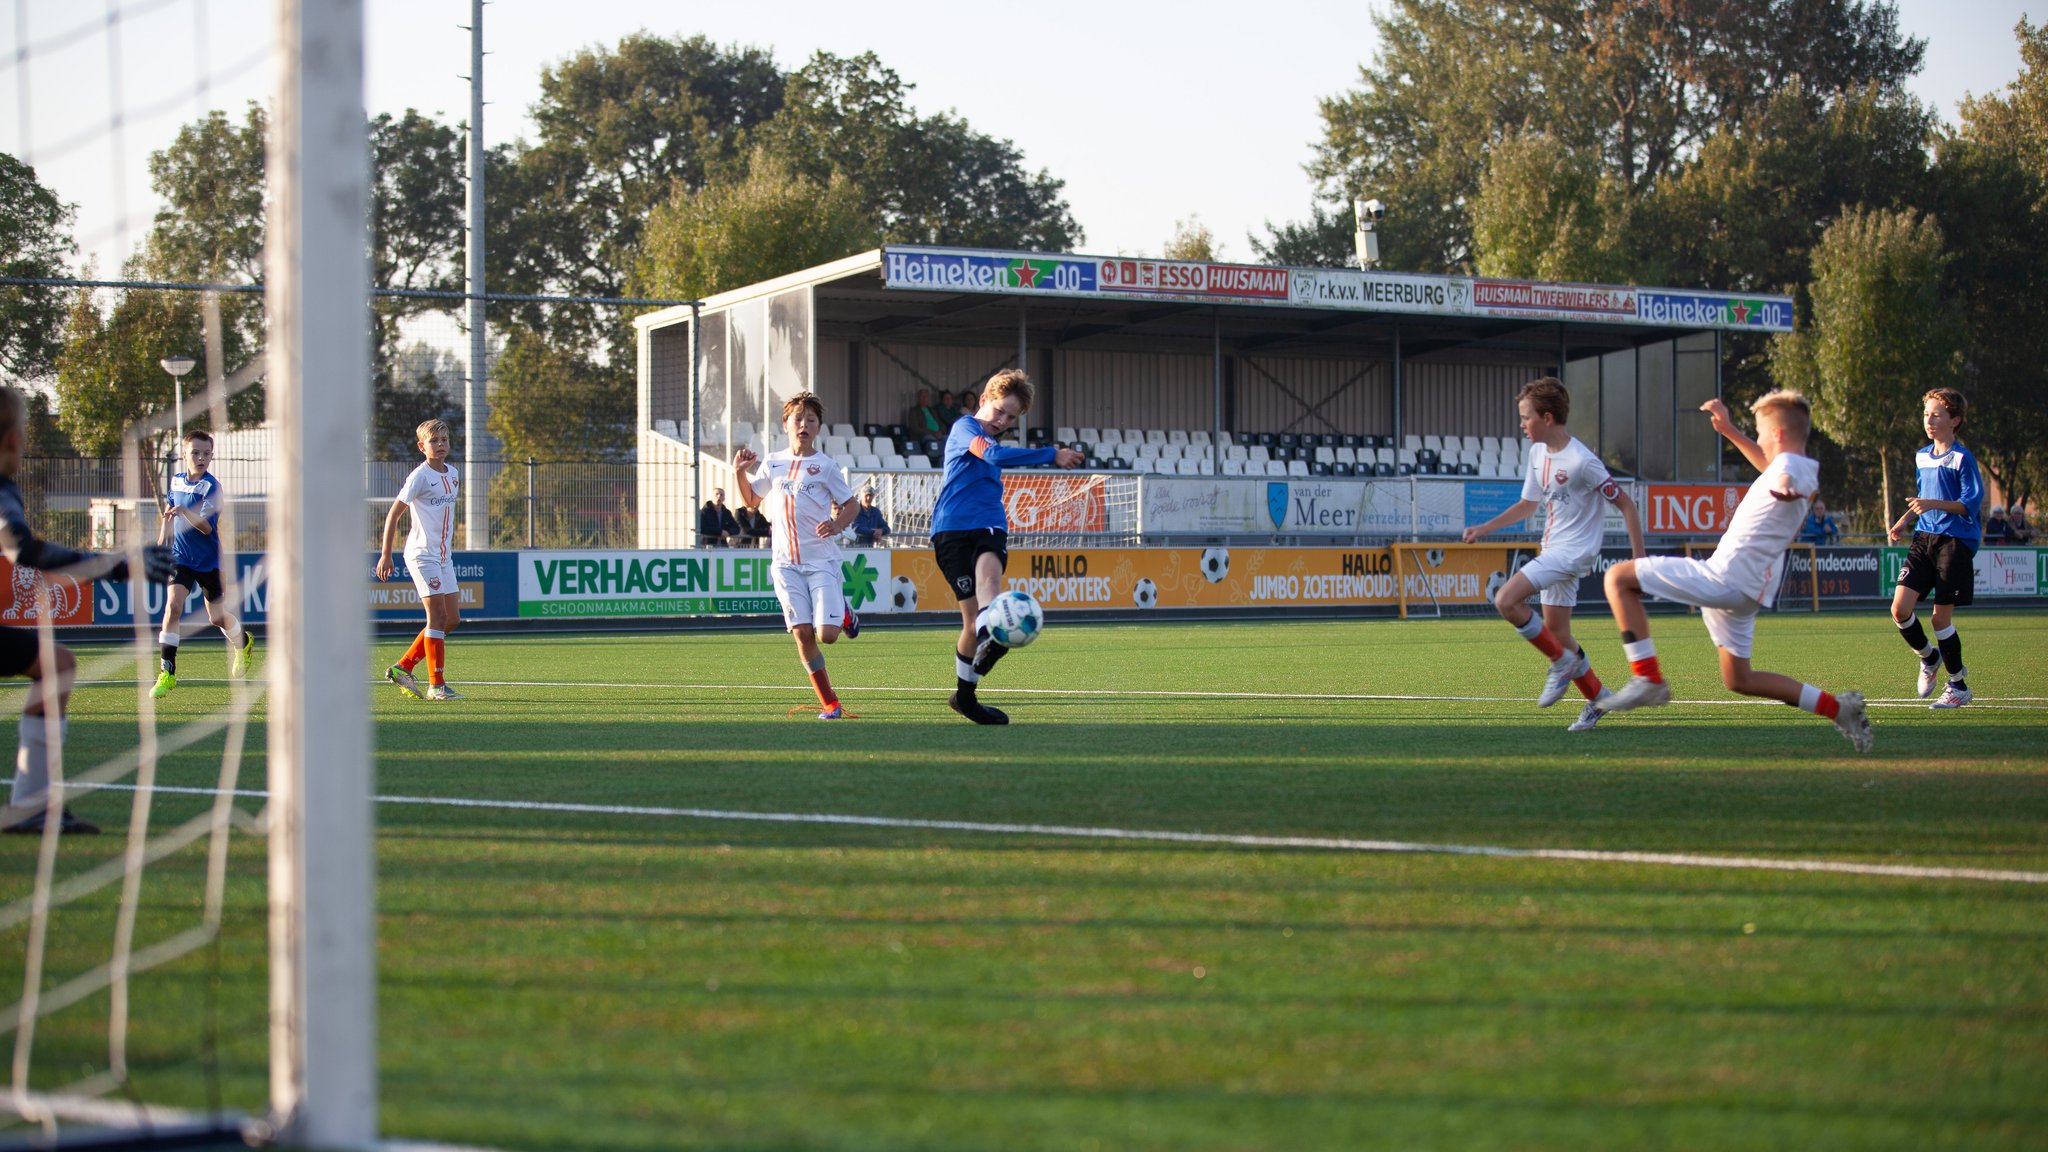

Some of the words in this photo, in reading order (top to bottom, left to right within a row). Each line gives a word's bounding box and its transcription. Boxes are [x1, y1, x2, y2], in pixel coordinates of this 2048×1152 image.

[888, 254, 1009, 290] Heineken
[1159, 266, 1203, 288] ESSO
[1207, 268, 1287, 292] HUISMAN
[1319, 280, 1359, 301] r.k.v.v.
[1363, 282, 1445, 305] MEERBURG
[1475, 286, 1531, 304] HUISMAN
[1533, 290, 1610, 308] TWEEWIELERS
[1638, 295, 1729, 325] Heineken
[1294, 488, 1312, 497] van
[1315, 485, 1331, 497] der
[1295, 498, 1355, 527] Meer
[1361, 509, 1449, 529] verzekerngen
[1653, 496, 1715, 530] ING
[533, 558, 709, 595] VERHAGEN
[716, 558, 774, 592] LEID
[1031, 555, 1088, 578] HALLO
[1343, 553, 1392, 576] HALLO
[1008, 577, 1111, 602] TOPSPORTERS
[1250, 576, 1299, 600] JUMBO
[1303, 575, 1399, 599] ZOETERWOUDE
[541, 602, 691, 614] SCHOONMAAKMACHINES
[699, 600, 706, 611] &
